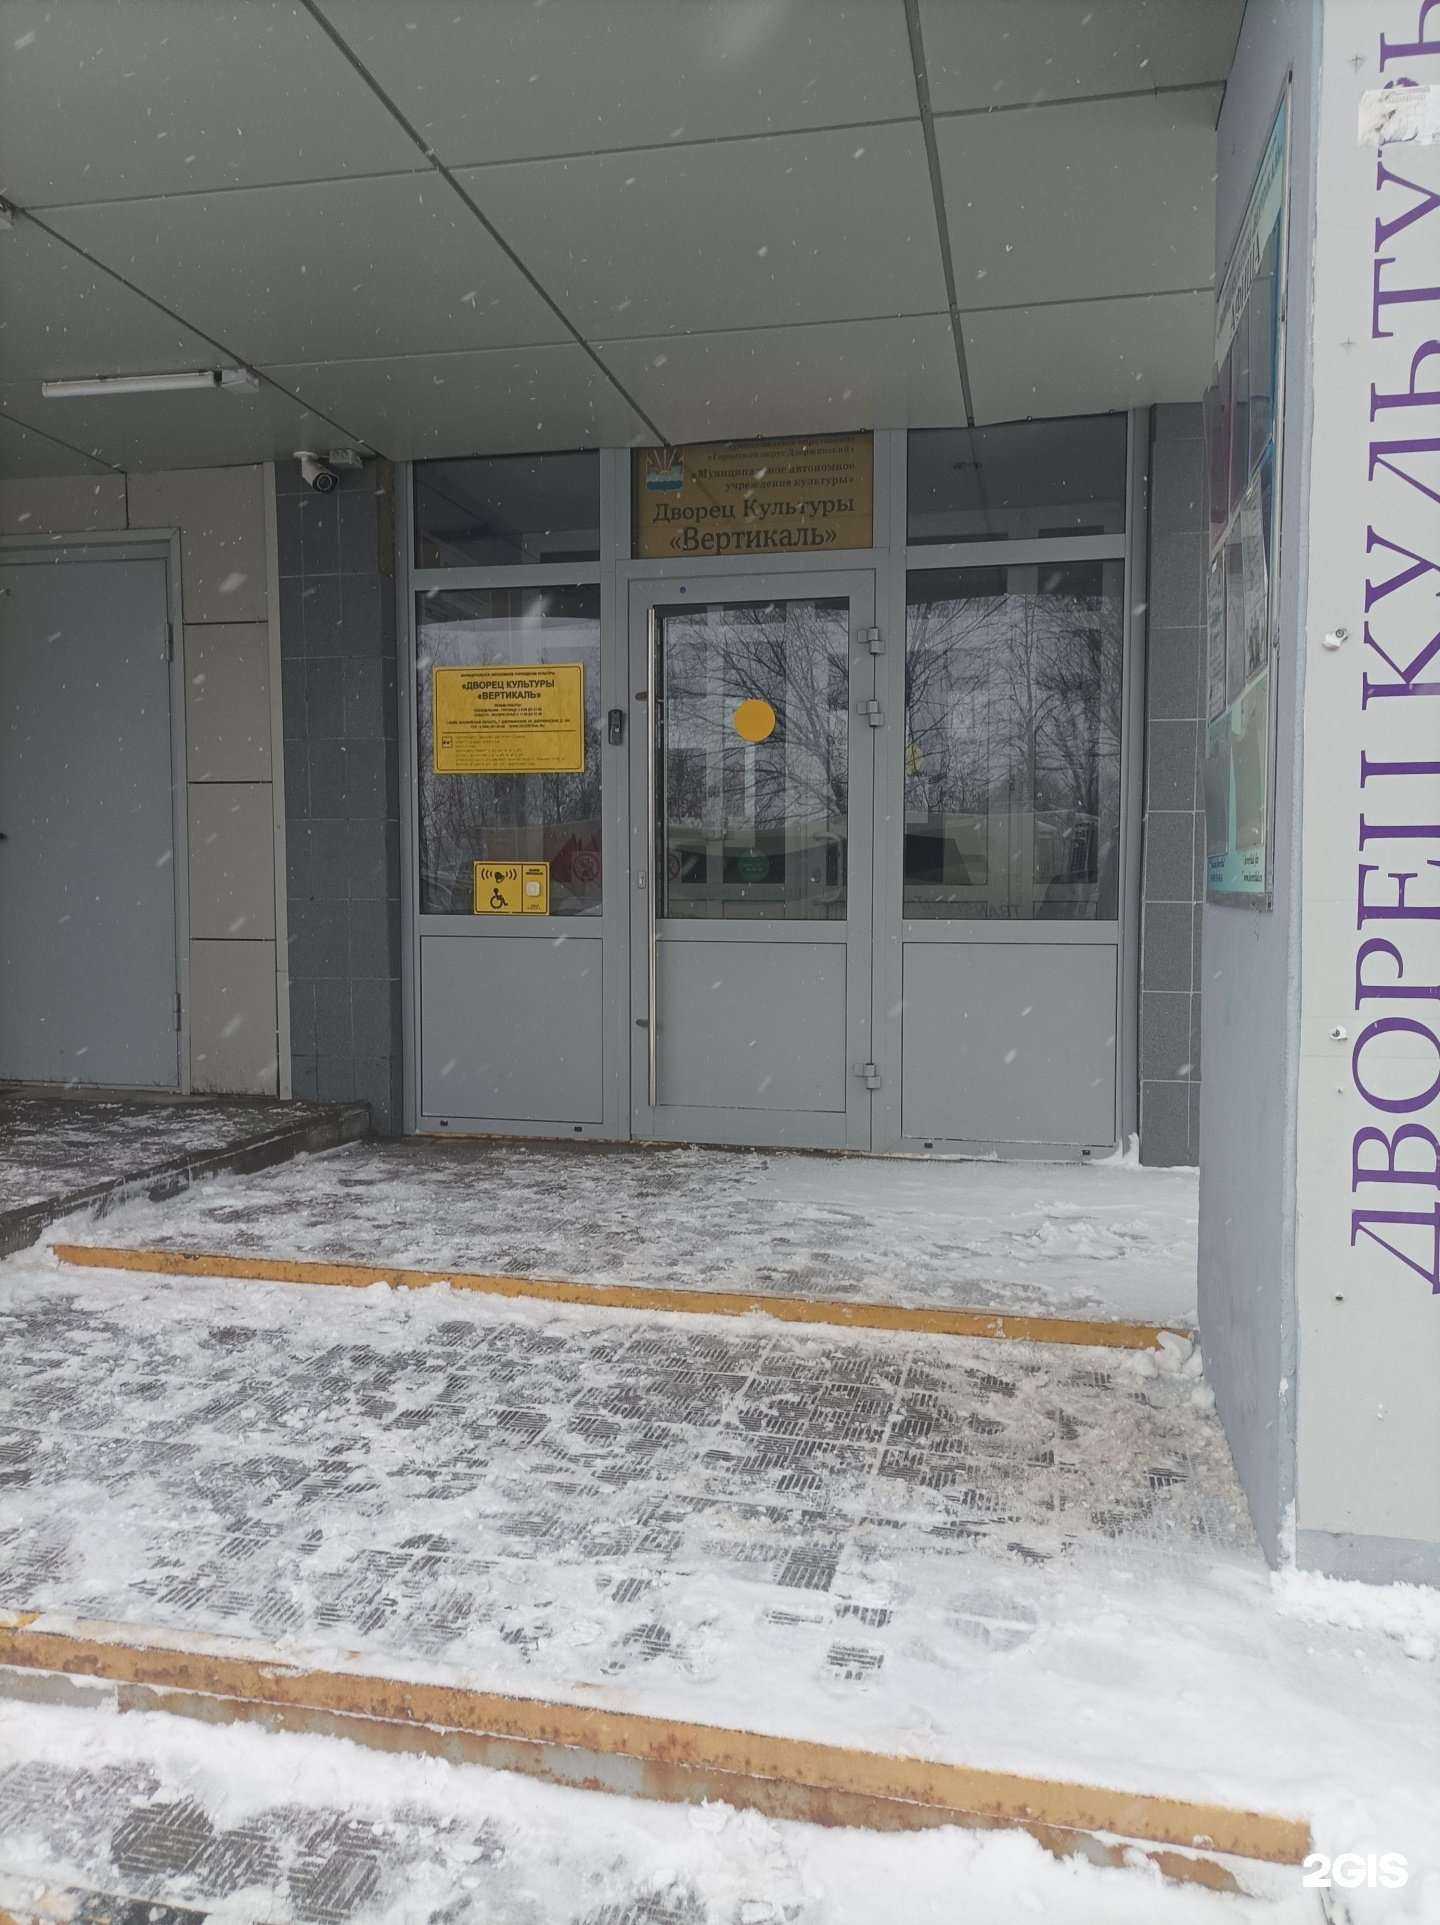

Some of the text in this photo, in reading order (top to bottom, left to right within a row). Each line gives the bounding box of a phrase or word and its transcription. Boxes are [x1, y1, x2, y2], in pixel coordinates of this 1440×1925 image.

[653, 497, 856, 523] Дворец Культуры
[669, 525, 837, 555] «Вертикаль»
[462, 679, 555, 690] «ДВОРЕЦ КУЛЬТУРЫ
[477, 690, 542, 701] «ВЕРТИКАЛЬ»
